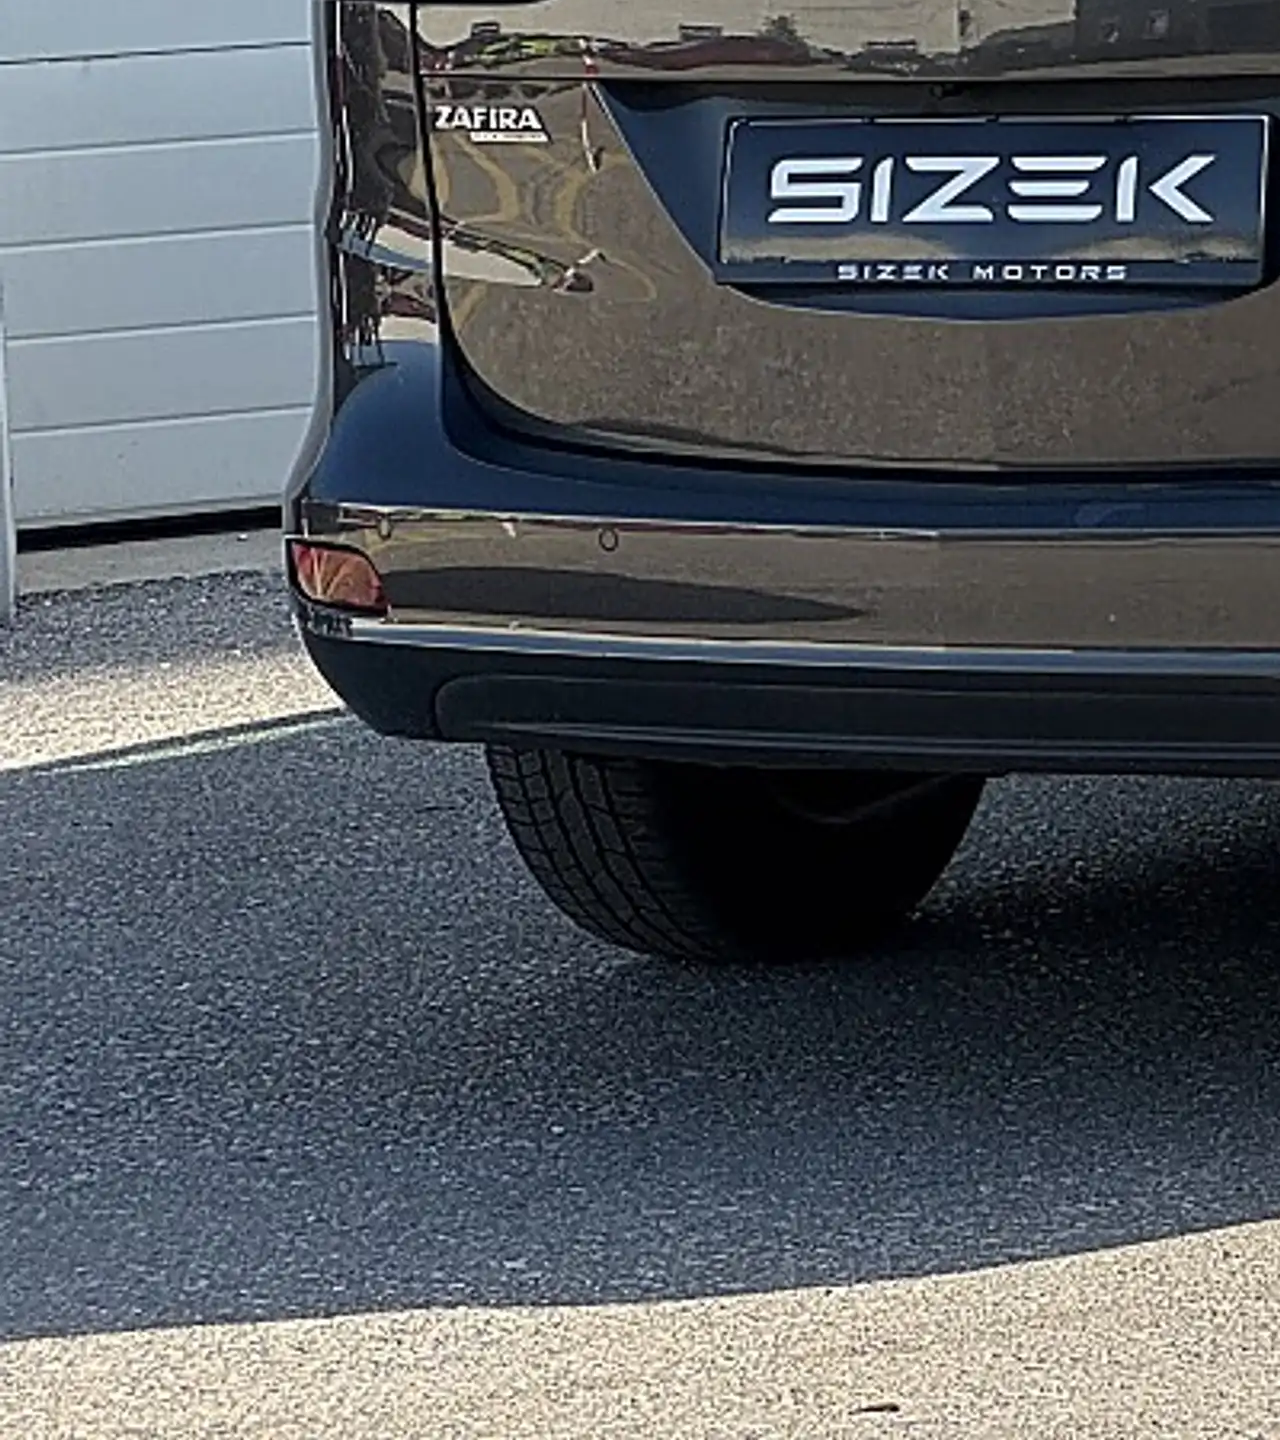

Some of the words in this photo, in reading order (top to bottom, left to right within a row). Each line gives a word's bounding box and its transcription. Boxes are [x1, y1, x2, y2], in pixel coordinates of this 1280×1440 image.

[434, 105, 542, 129] ZAFIRA
[768, 155, 1215, 223] SIZEK
[837, 264, 949, 281] SIZEK
[973, 264, 1127, 281] MOTORS
